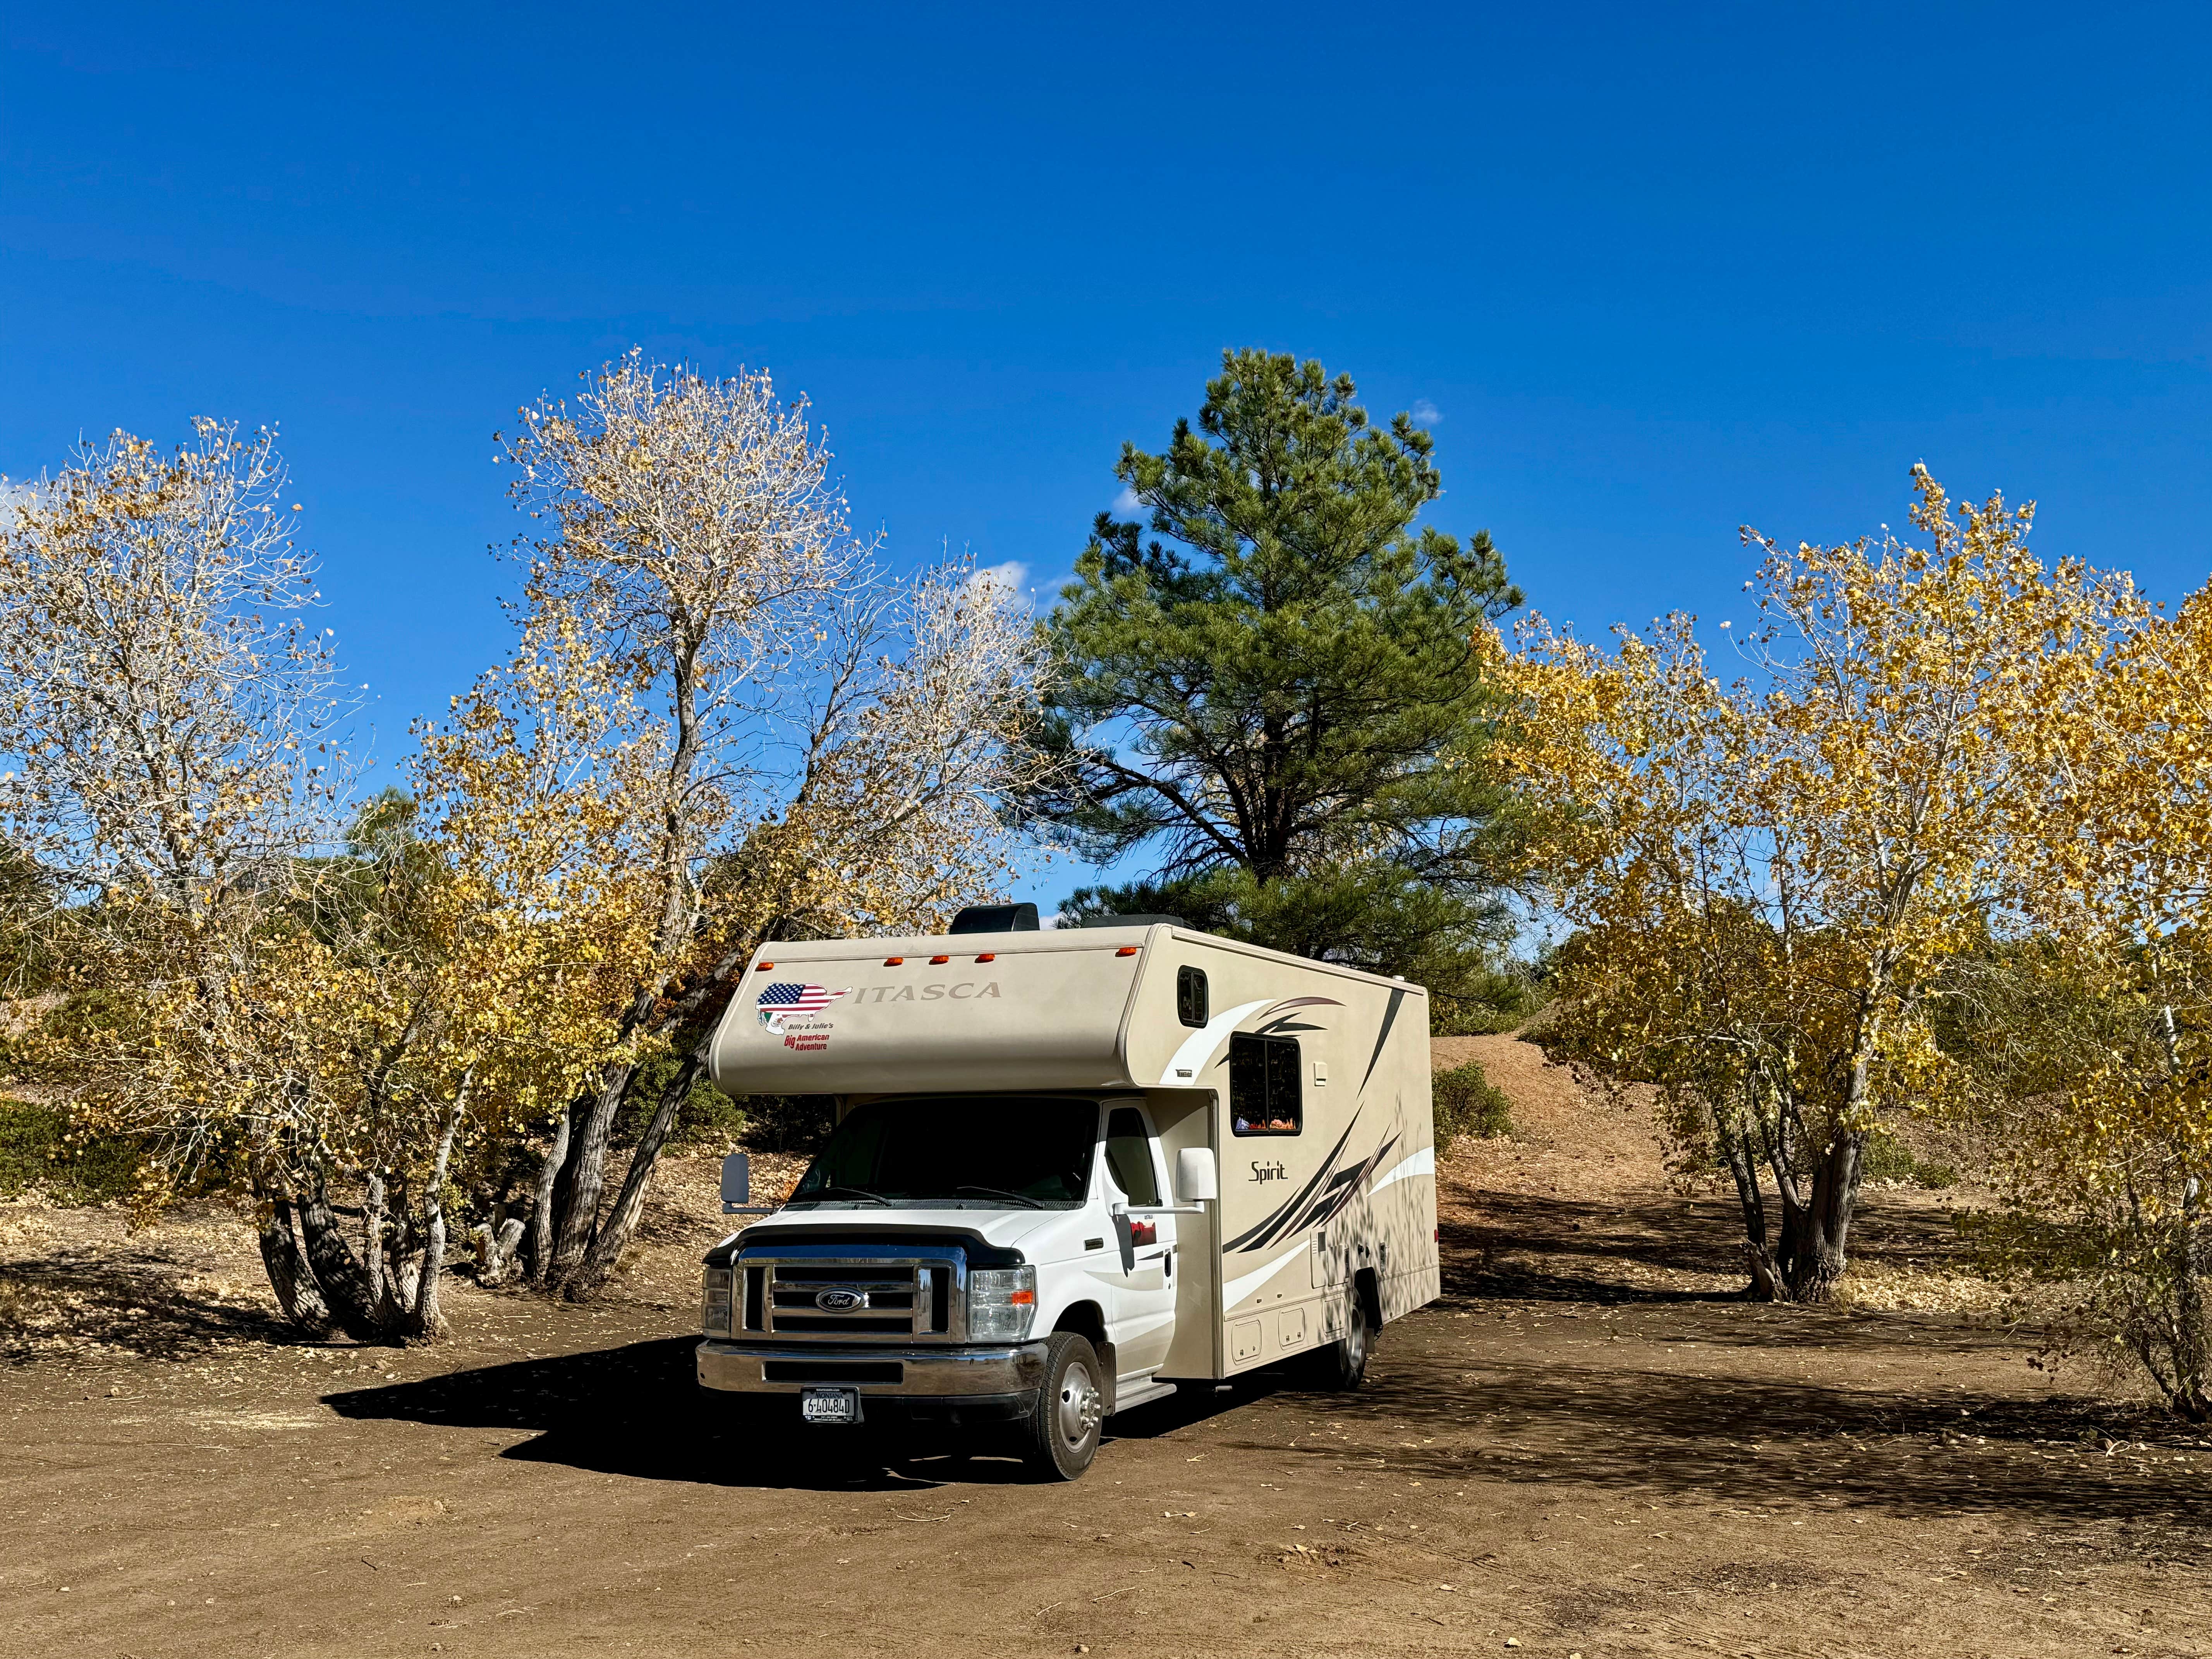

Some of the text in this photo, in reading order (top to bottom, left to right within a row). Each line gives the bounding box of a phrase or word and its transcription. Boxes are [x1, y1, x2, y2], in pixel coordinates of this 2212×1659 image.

[852, 982, 1002, 1004] ITASCA
[784, 1035, 796, 1049] Big
[1248, 1160, 1288, 1185] Spirit
[828, 1294, 850, 1305] Ford
